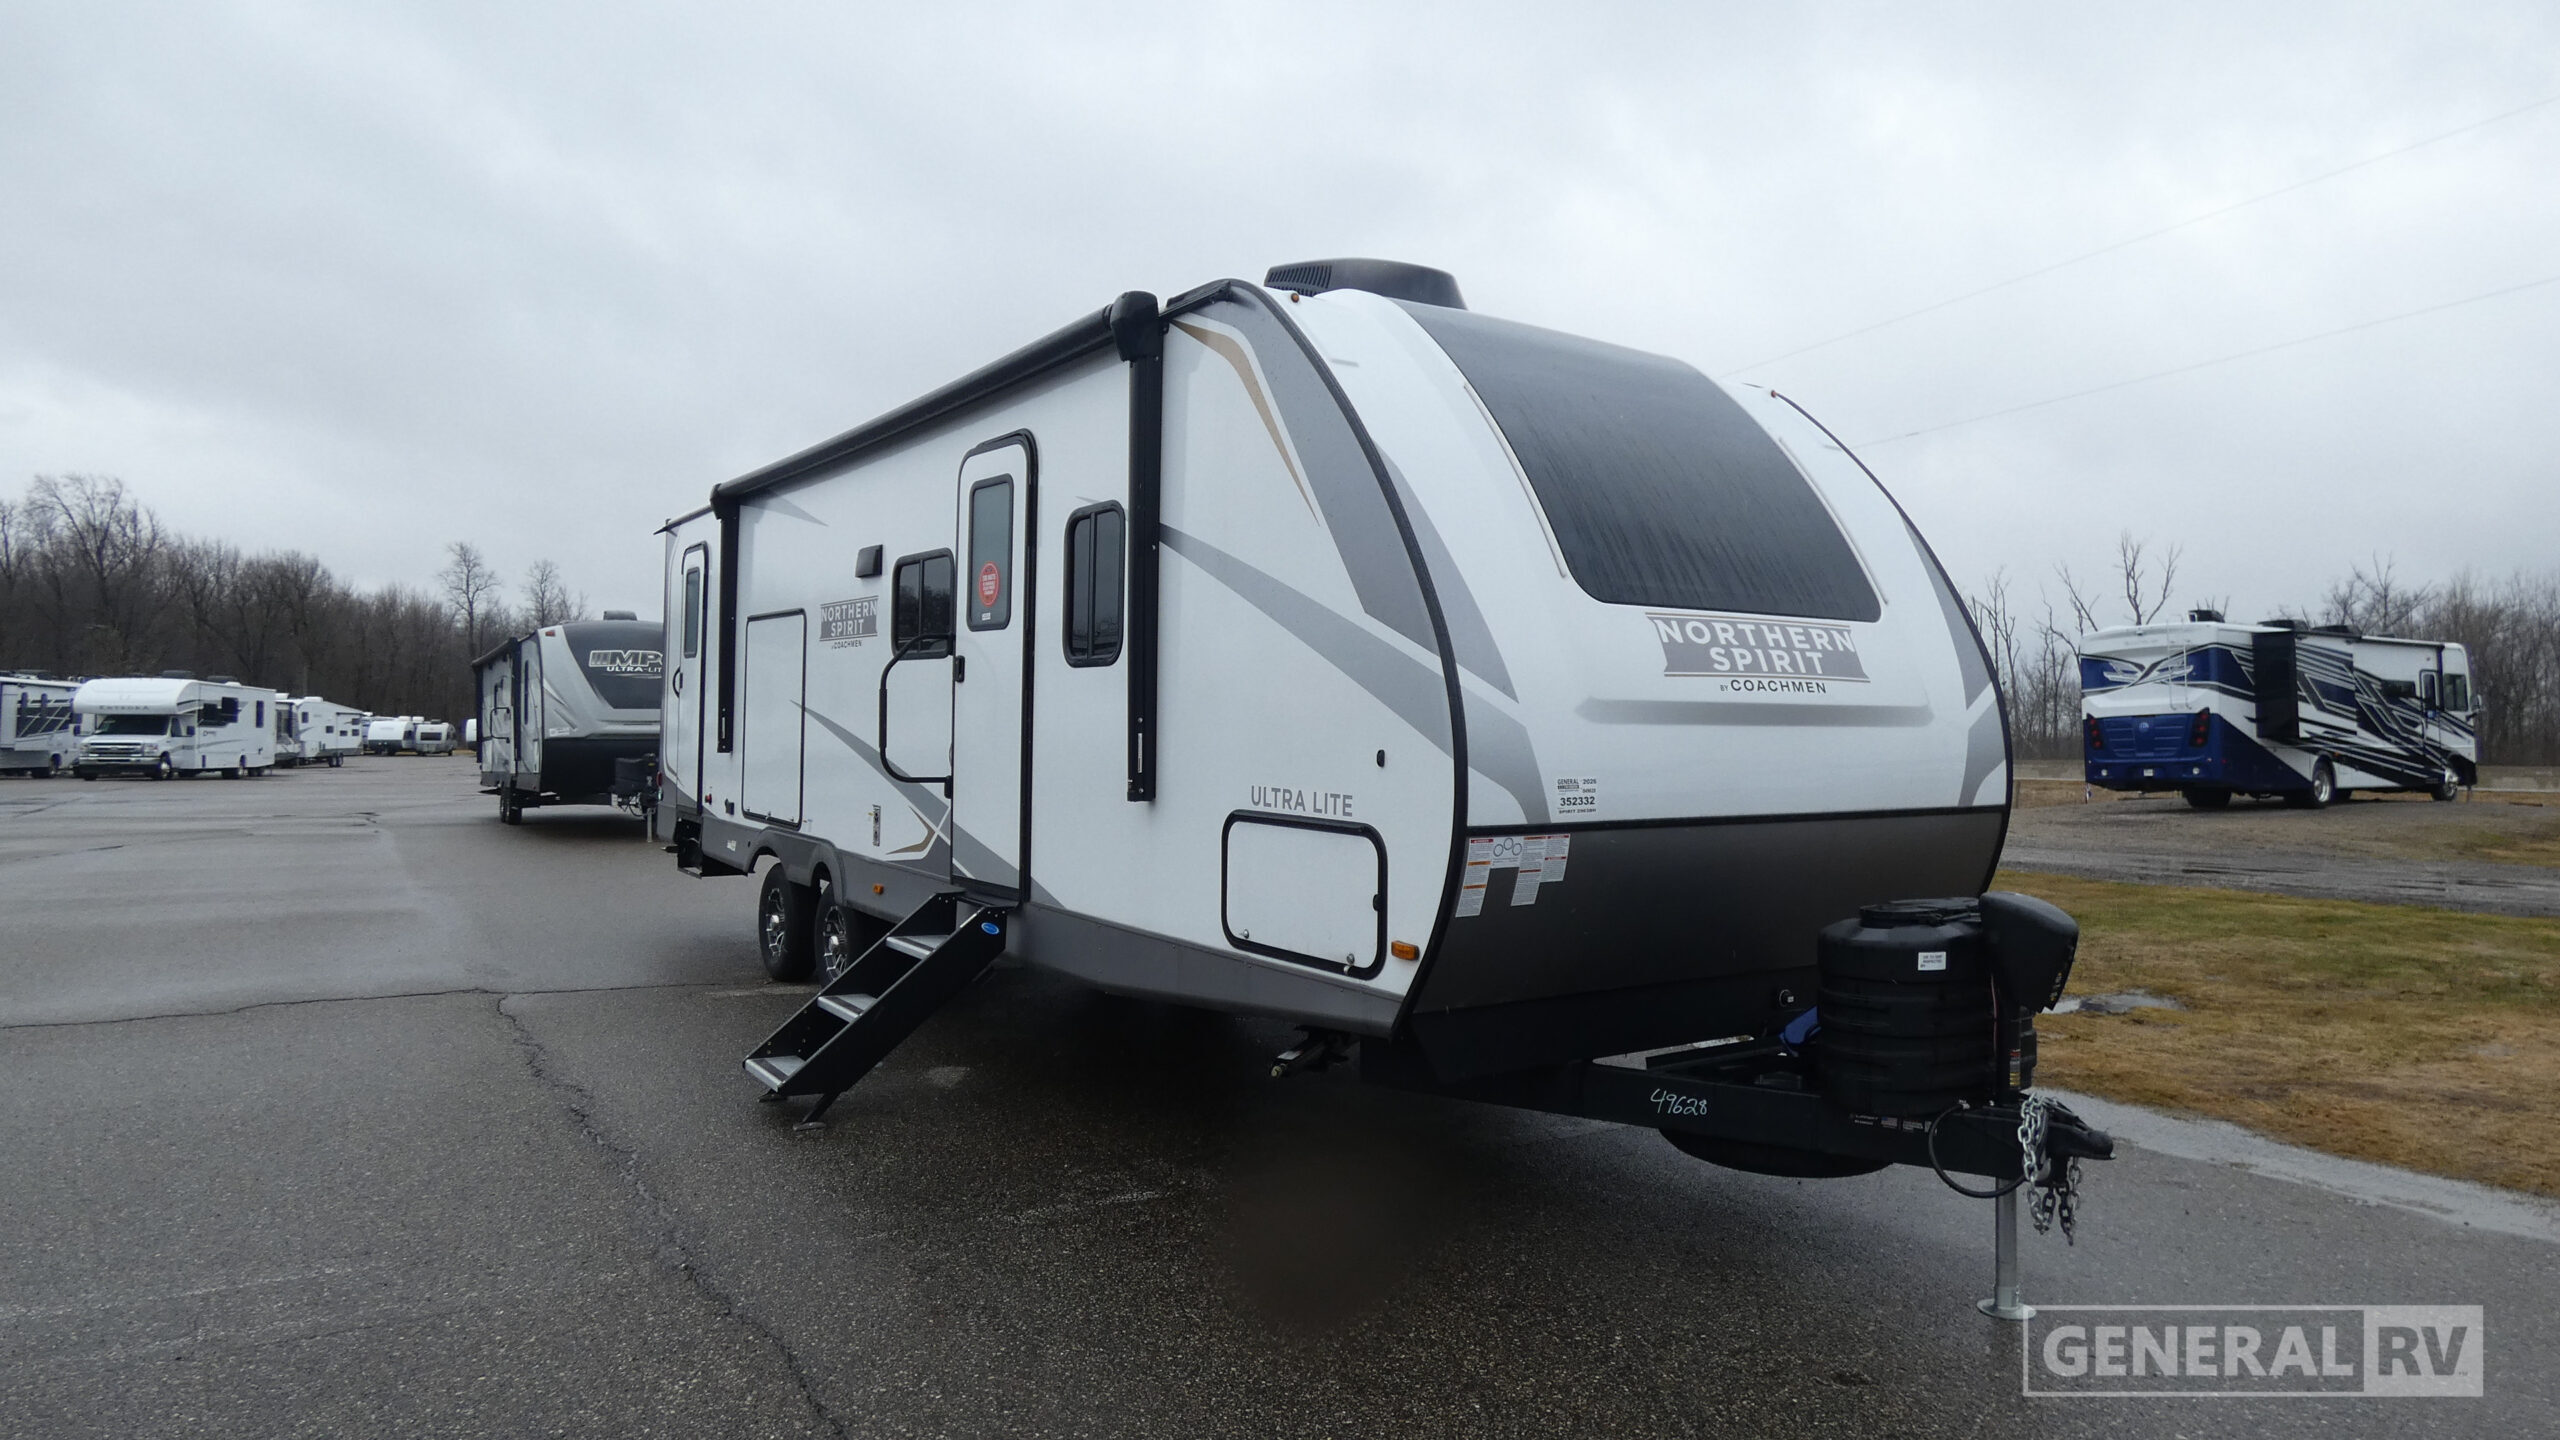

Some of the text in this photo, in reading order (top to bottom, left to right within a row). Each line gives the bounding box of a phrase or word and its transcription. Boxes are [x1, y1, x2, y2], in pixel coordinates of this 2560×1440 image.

[821, 600, 877, 622] NORTHERN
[830, 619, 864, 637] SPIRIT
[1653, 619, 1856, 652] NORTHERN
[1709, 647, 1823, 674] SPIRIT
[1719, 679, 1827, 694] BY COACHMEN
[1250, 785, 1353, 817] ULTRA LITE
[1560, 796, 1596, 807] 352332
[1650, 1088, 1708, 1116] 49628
